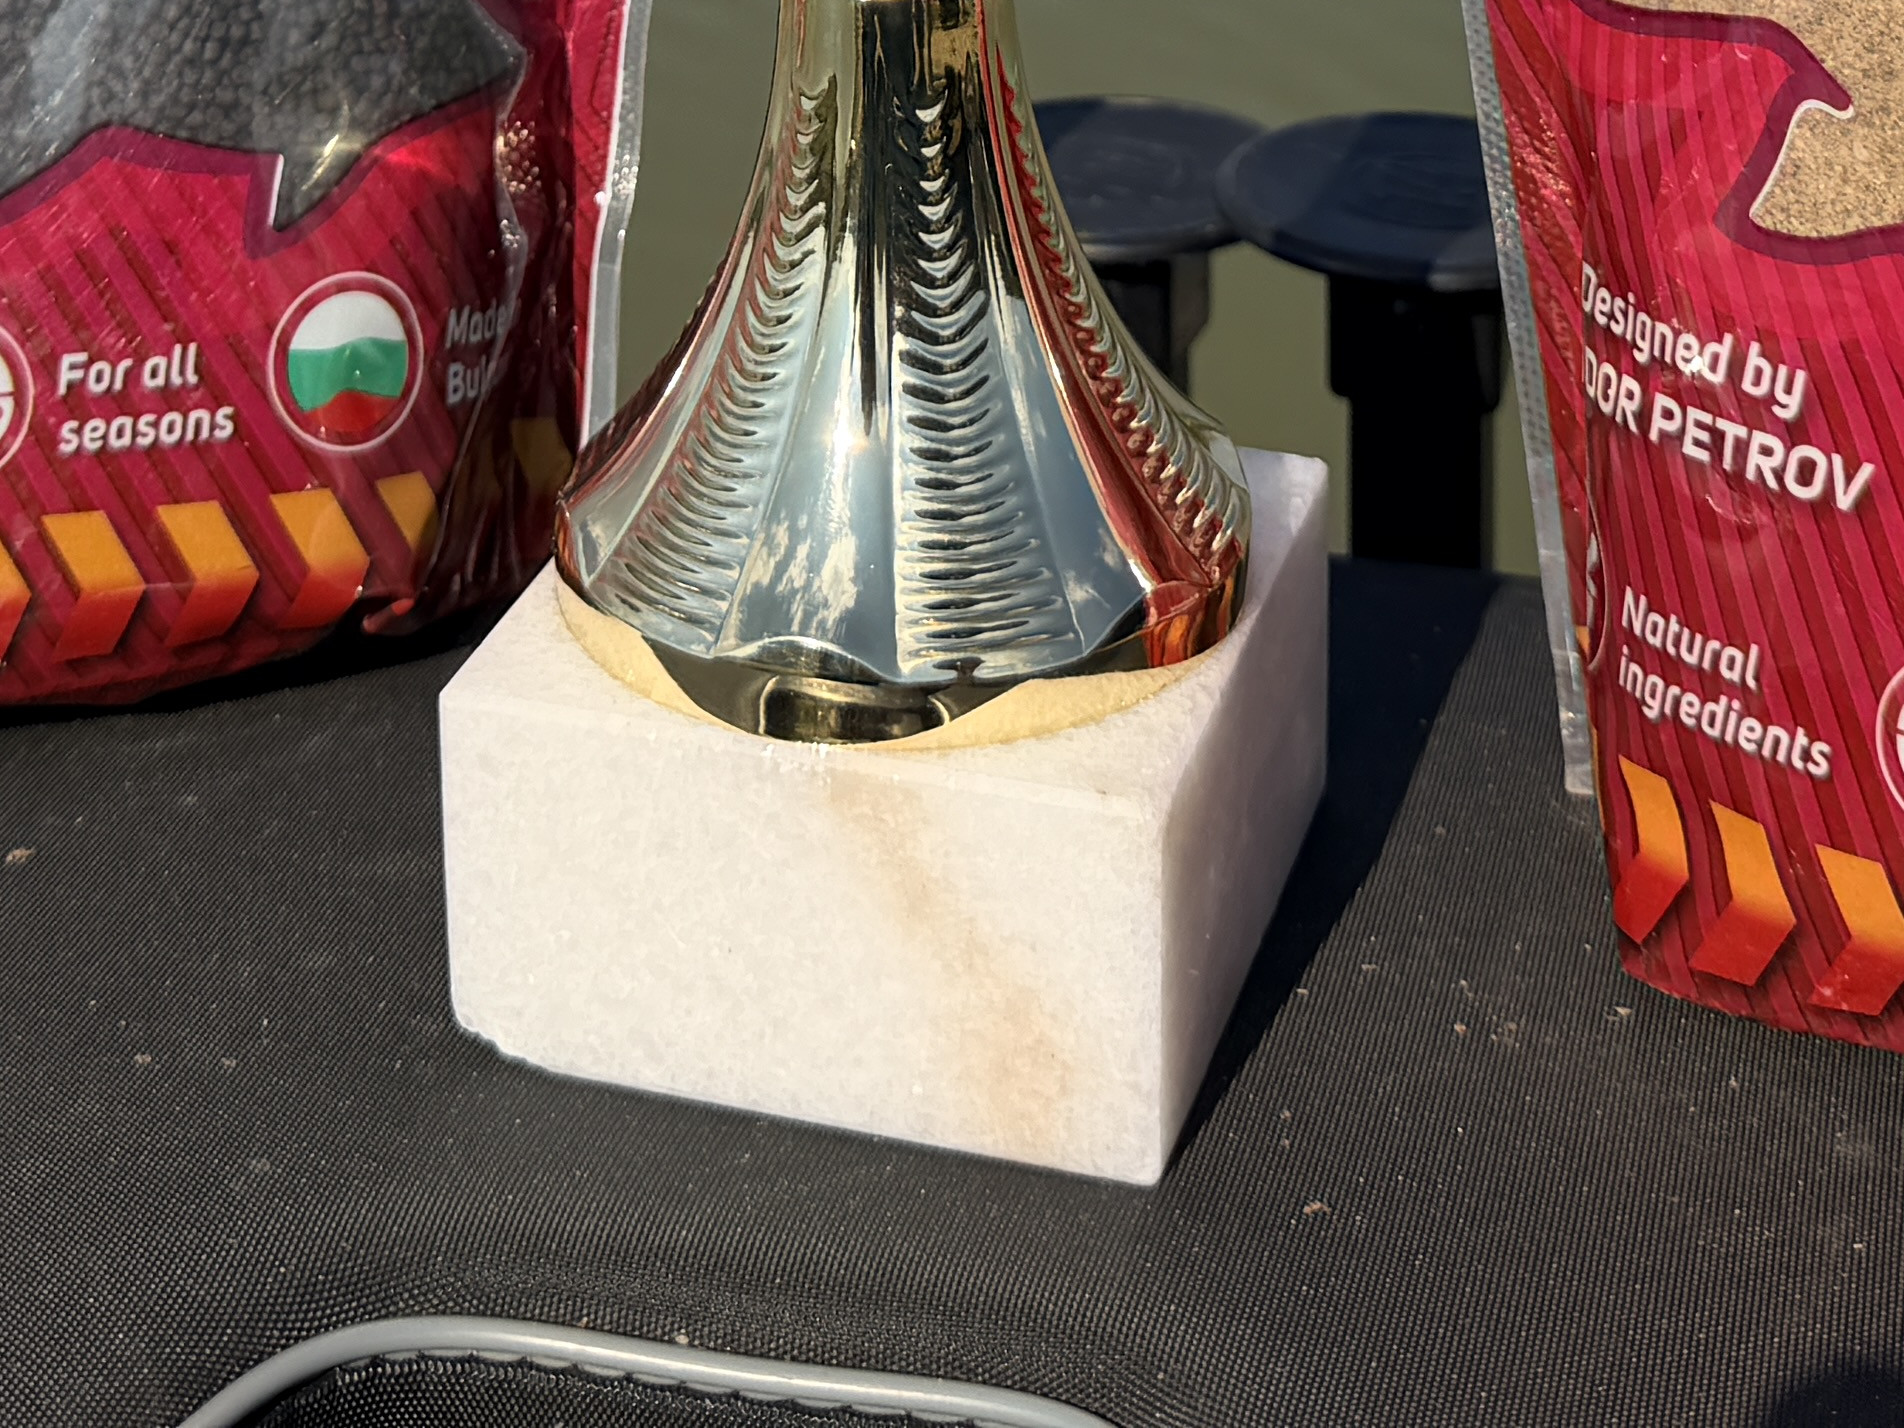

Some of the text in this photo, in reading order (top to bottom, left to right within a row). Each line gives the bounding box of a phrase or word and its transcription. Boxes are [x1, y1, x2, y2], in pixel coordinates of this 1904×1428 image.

[58, 342, 199, 397] For all
[1582, 260, 1808, 422] Designed by
[57, 405, 236, 455] seasons
[1583, 345, 1877, 513] DOR PETROV
[1621, 584, 1760, 692] Natural
[1618, 644, 1834, 779] ingredients
